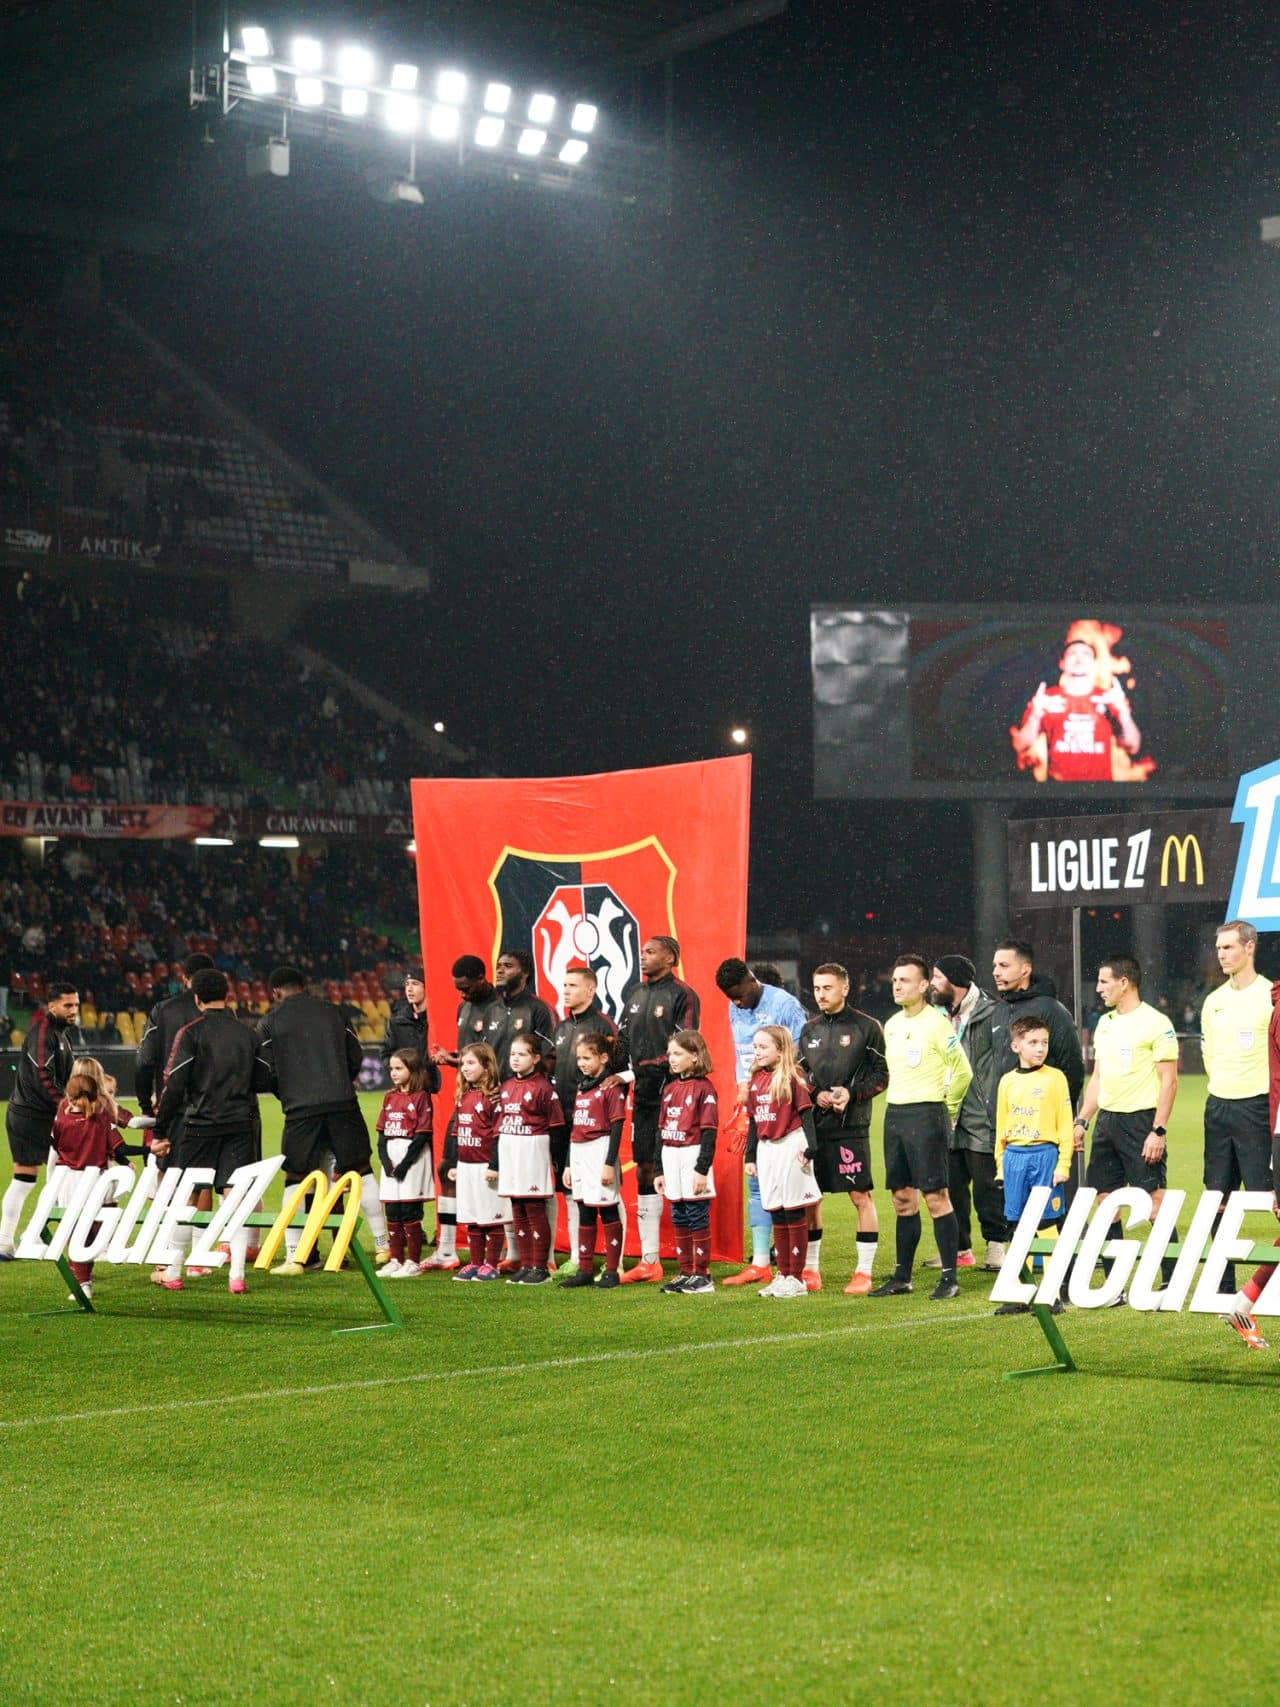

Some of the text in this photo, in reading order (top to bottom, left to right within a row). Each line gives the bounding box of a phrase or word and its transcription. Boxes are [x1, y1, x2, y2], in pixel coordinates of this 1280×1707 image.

[1030, 838, 1120, 893] LIGUE
[838, 1161, 863, 1175] BWT
[15, 1165, 217, 1266] LIGUE
[988, 1185, 1275, 1314] LIGUE
